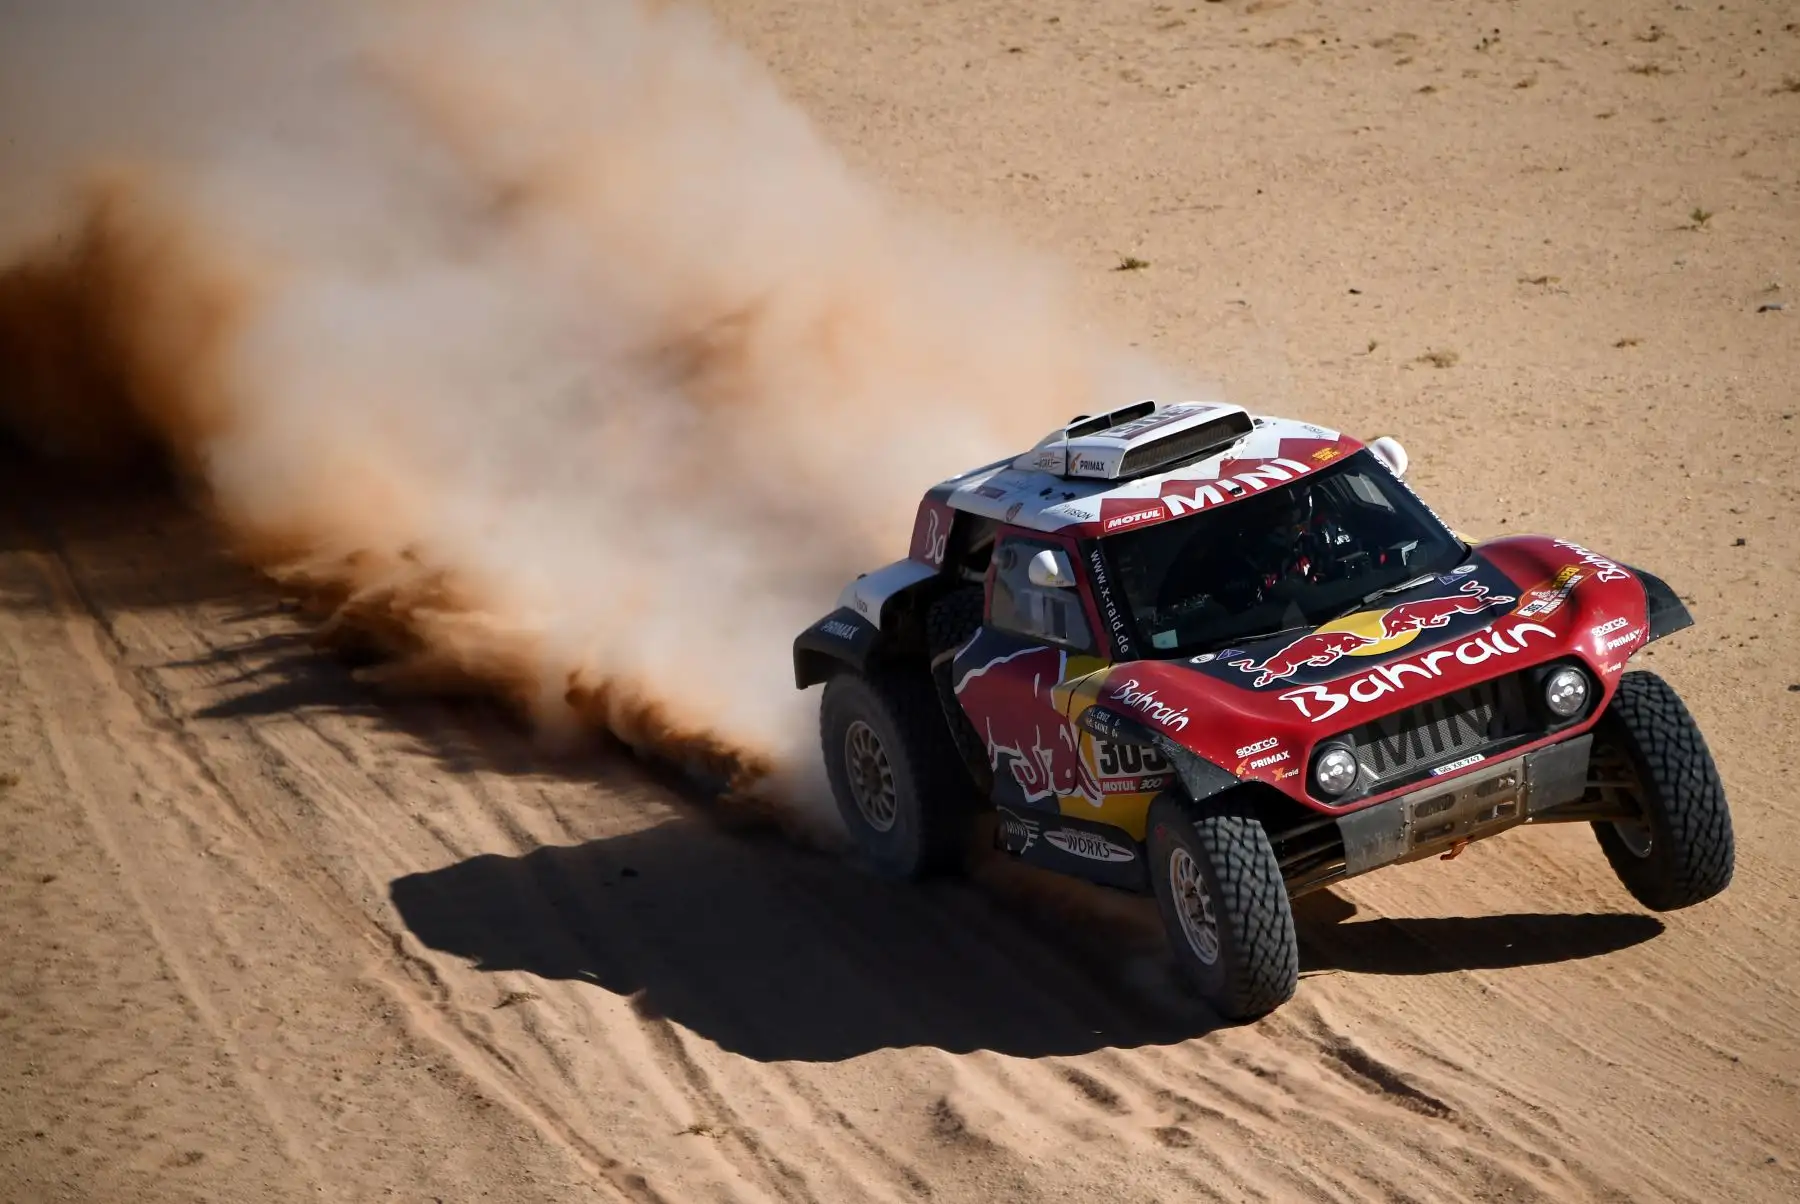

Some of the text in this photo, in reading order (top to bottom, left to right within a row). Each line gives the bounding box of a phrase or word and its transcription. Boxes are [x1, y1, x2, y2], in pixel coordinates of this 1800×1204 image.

[1079, 460, 1105, 472] PRIMAX
[1161, 457, 1312, 517] MINI
[1107, 508, 1161, 529] MOTUL
[1090, 549, 1129, 654] www.x-raid.de
[1278, 620, 1557, 723] Bahrain
[1110, 679, 1189, 732] Bahrain
[1100, 741, 1169, 775] 305
[1235, 737, 1279, 758] sparco
[1250, 750, 1290, 769] PRIMAX
[1102, 778, 1164, 792] MOTUL 300
[1065, 833, 1111, 859] WORKS
